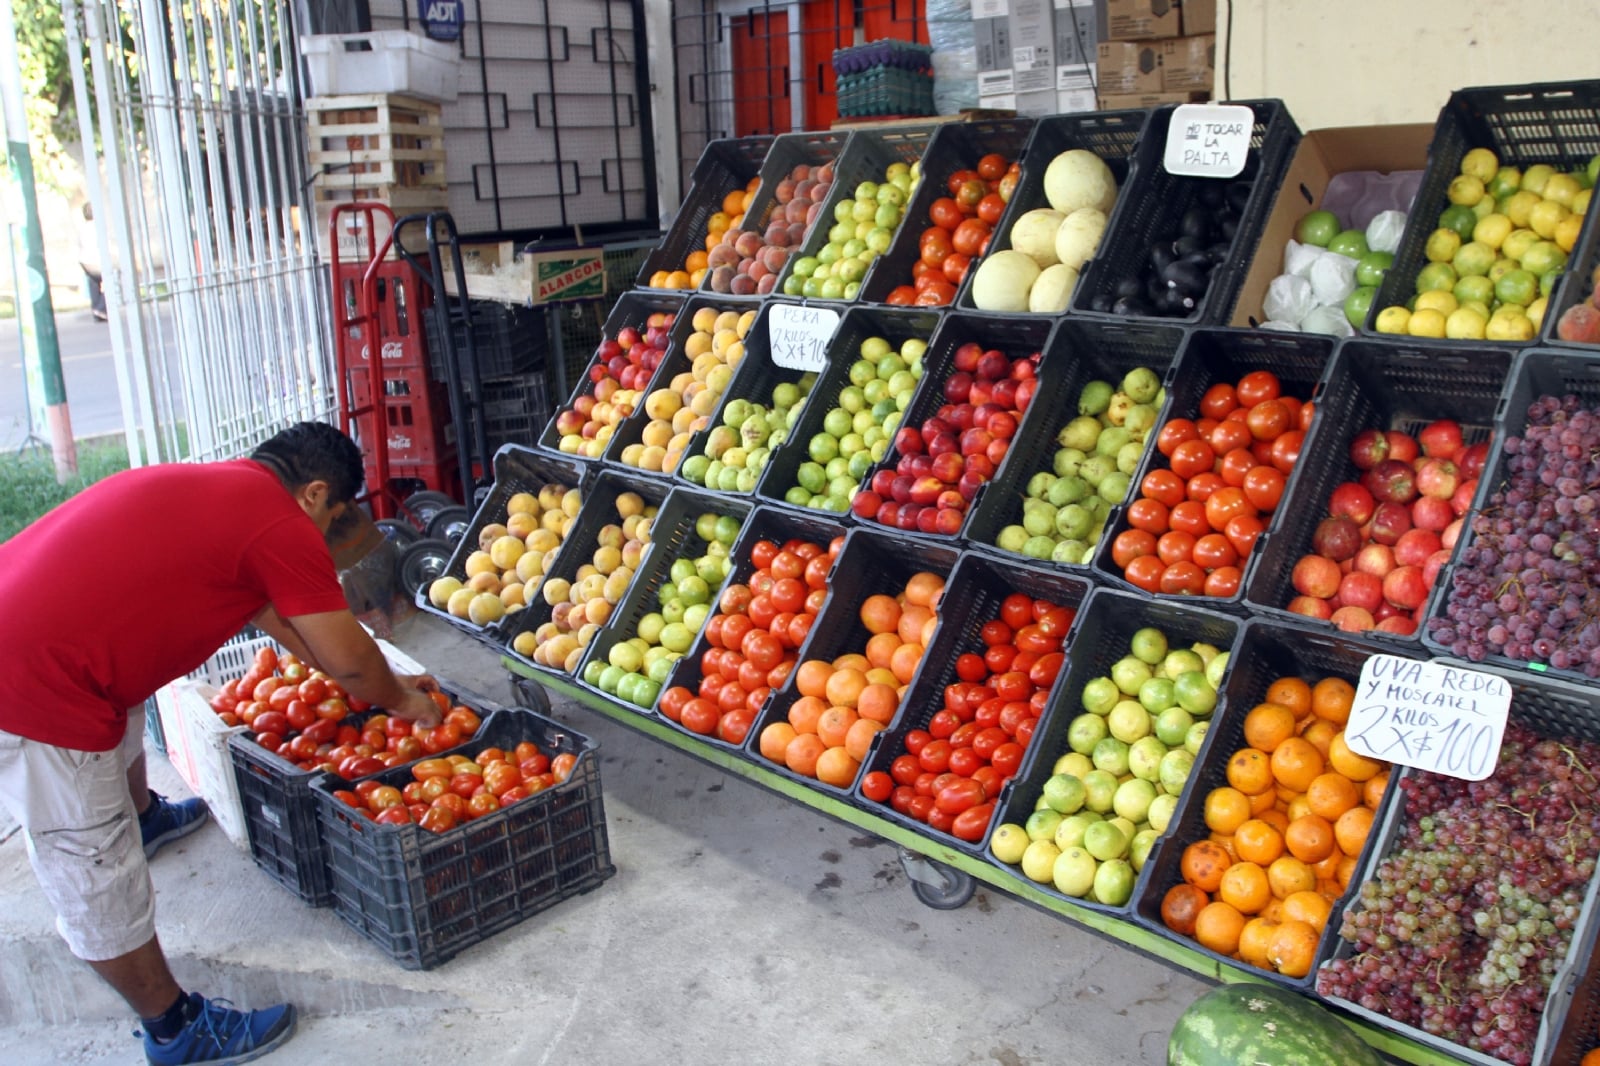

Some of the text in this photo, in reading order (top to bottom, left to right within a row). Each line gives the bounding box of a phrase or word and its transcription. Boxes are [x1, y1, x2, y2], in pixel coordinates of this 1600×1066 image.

[427, 2, 457, 22] ADT
[1185, 122, 1243, 140] NO TOCAR
[1204, 137, 1220, 148] LA
[1184, 149, 1230, 166] PALTA
[539, 259, 603, 297] ALARCON
[783, 307, 819, 324] PERA
[772, 327, 782, 353] 2
[1364, 680, 1488, 717] Y MOSCATEL
[1350, 704, 1440, 755] 2 KILOS
